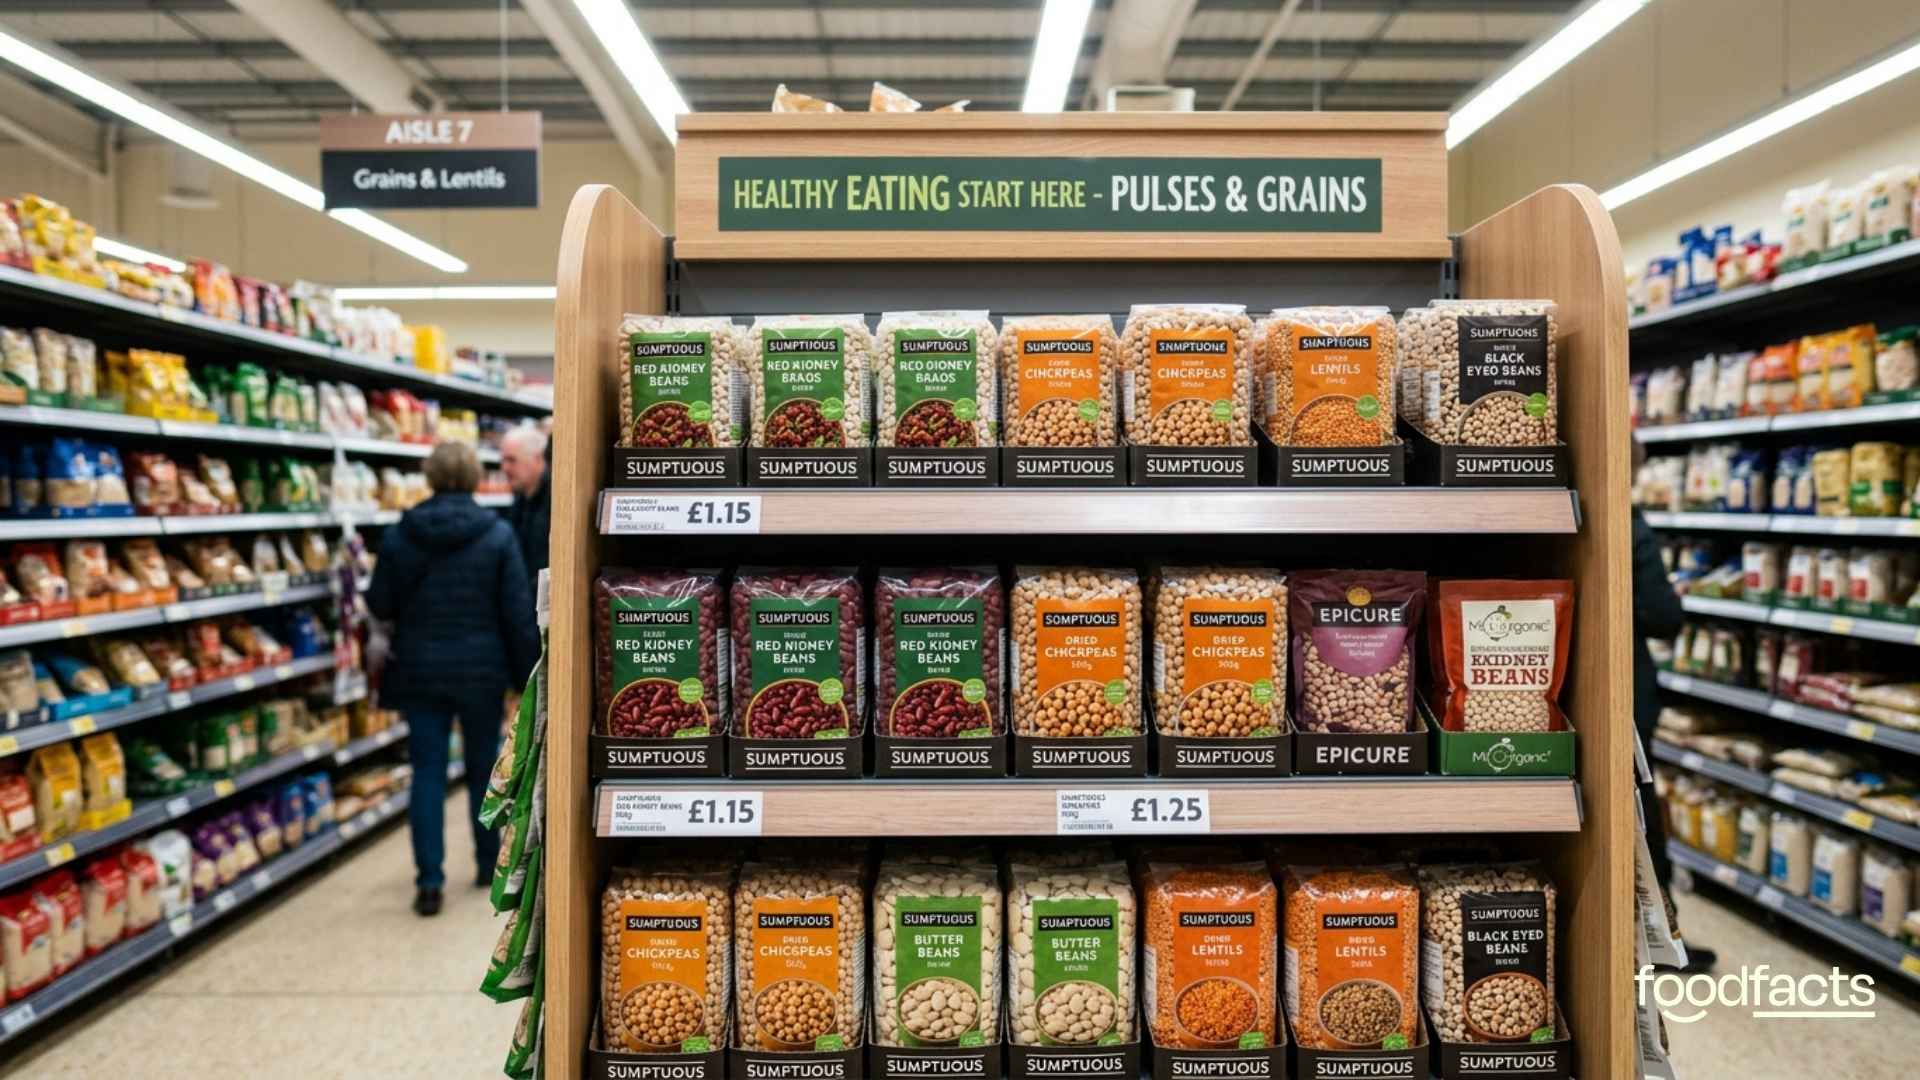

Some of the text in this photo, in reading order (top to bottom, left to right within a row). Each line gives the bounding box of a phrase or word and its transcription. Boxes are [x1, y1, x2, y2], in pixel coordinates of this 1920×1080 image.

[385, 120, 474, 144] AISLE 7
[353, 166, 506, 190] Grains & Lentils
[734, 179, 838, 209] HEALTHY
[847, 175, 950, 211] EATING
[958, 180, 1024, 208] START
[1031, 180, 1086, 208] HERE
[1111, 175, 1216, 212] PULSES
[1225, 175, 1248, 212] &
[1256, 175, 1367, 213] GRAINS
[1485, 352, 1525, 363] BLACK
[627, 461, 725, 475] SUMPTUOUS
[760, 461, 857, 475] SUMPTUOUS
[888, 461, 986, 475] SUMPTUOUS
[1017, 460, 1114, 474] SUMPTUOUS
[1147, 459, 1244, 473] SUMPTUOUS
[1292, 459, 1390, 472] SUMPTUOUS
[1456, 458, 1554, 472] SUMPTUOUS
[687, 502, 751, 524] £1.15
[759, 612, 830, 623] SUMPTUOUS
[1193, 614, 1265, 625] SUMPTUOUS
[1320, 608, 1401, 623] EPICURE
[616, 639, 640, 650] RED
[756, 640, 781, 651] RED
[900, 640, 926, 651] RED
[633, 652, 676, 663] BEANS
[774, 653, 817, 664] BEANS
[918, 653, 960, 664] BEANS
[1471, 668, 1549, 685] BEANS
[608, 751, 706, 764] SUMPTUOUS
[746, 752, 845, 765] SUMPTUOUS
[892, 750, 989, 764] SUMPTUOUS
[1032, 750, 1130, 763] SUMPTUOUS
[1177, 750, 1274, 763] SUMPTUOUS
[1316, 746, 1411, 764] EPICURE
[688, 799, 754, 824] £1.15
[1131, 798, 1202, 822] £1.25
[904, 914, 974, 924] SUMPTUOUS
[1041, 917, 1111, 928] SUMPTUOUS
[1183, 914, 1252, 925] SUMPTUOUS
[914, 934, 964, 945] BUTTER
[1052, 937, 1101, 948] BUTTER
[1468, 930, 1544, 942] BLACK EYED
[626, 947, 700, 959] CHICKPEAS
[918, 947, 960, 958] BEANS
[1056, 950, 1097, 961] BEANS
[1336, 945, 1386, 957] LENTILS
[887, 1060, 983, 1073] SUMPTUOUS
[1027, 1058, 1123, 1072] SUMPTUOUS
[1173, 1061, 1270, 1075] SUMPTUOUS
[1317, 1061, 1413, 1075] SUMPTUOUS
[1460, 1056, 1556, 1069] SUMPTUOUS
[608, 1066, 705, 1079] SUMPTUOUS
[747, 1063, 844, 1077] SUMPTUOUS
